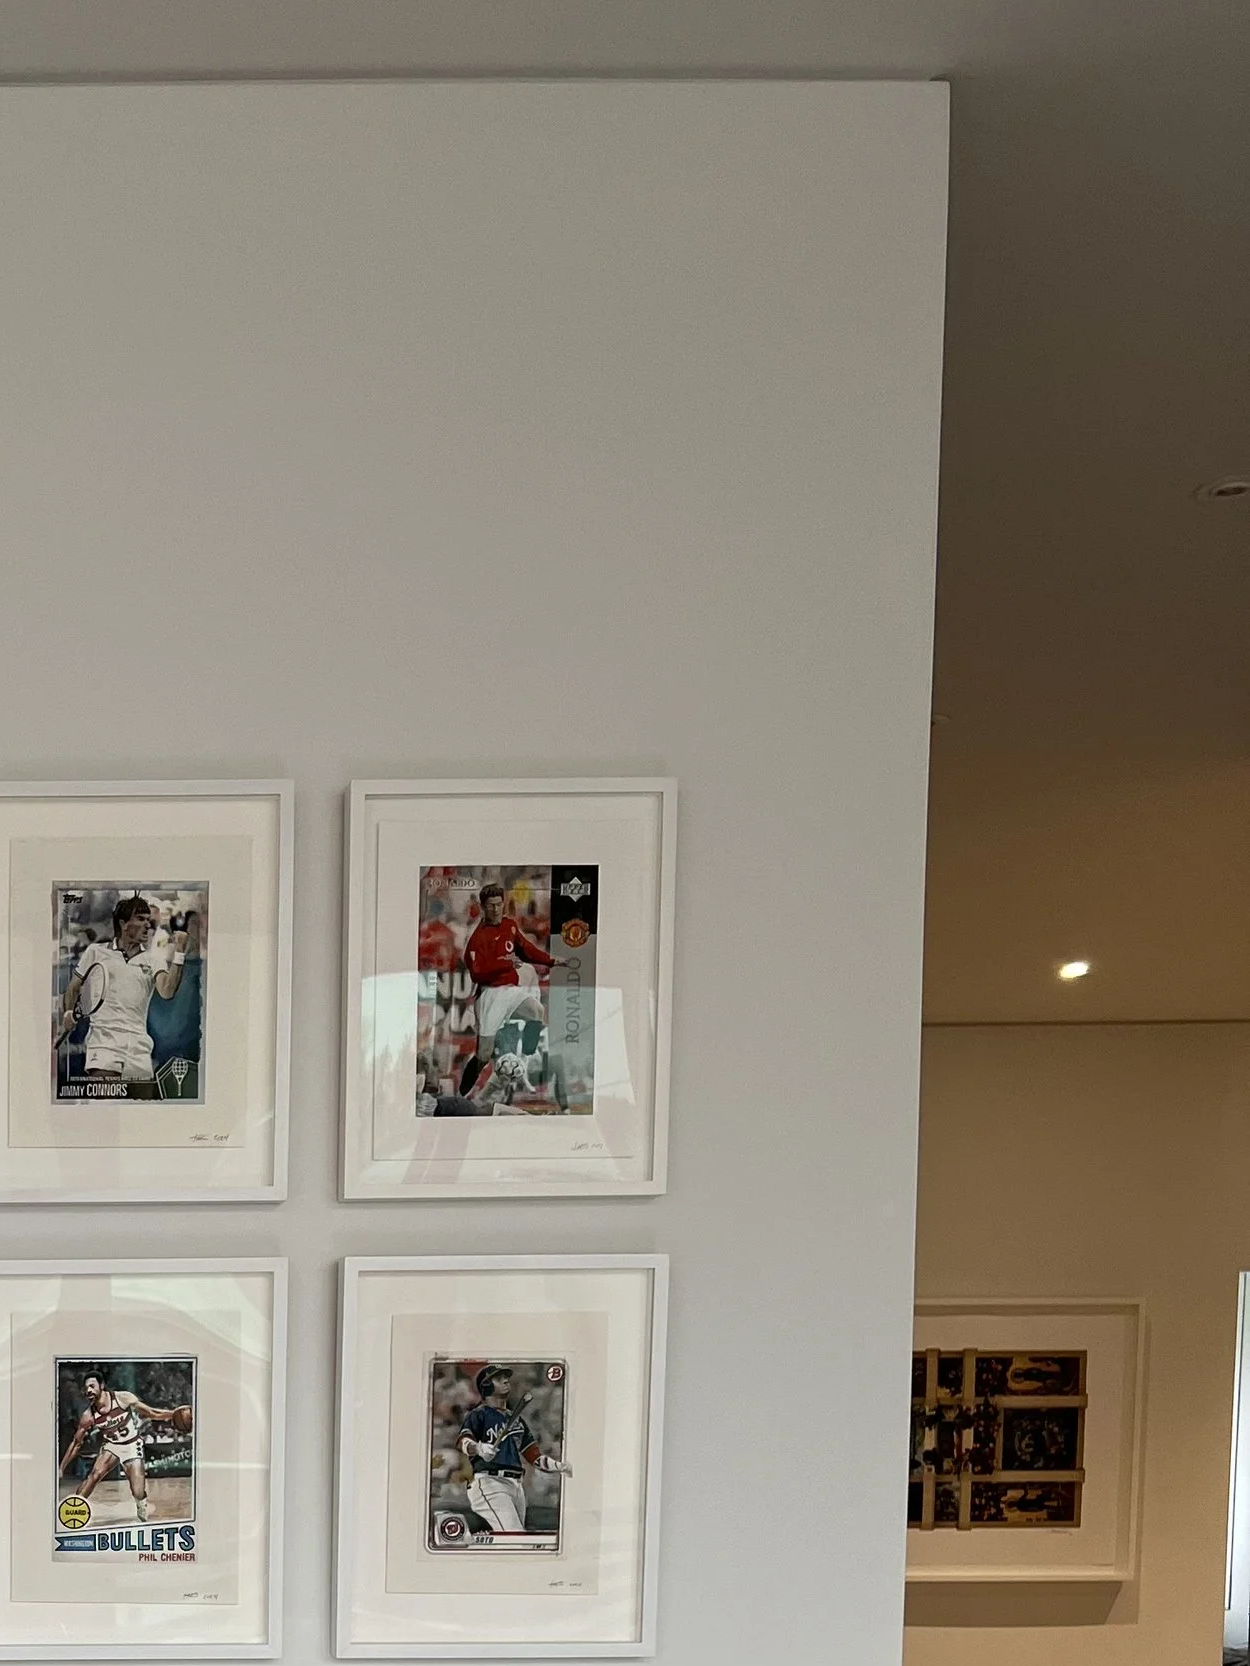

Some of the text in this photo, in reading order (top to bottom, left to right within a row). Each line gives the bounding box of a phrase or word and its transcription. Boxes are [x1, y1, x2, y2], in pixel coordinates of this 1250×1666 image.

[564, 956, 582, 1044] RONALDO
[59, 1083, 128, 1097] JIMMY CONNORS
[97, 1525, 196, 1552] BULLETS
[475, 1536, 494, 1544] SOTO
[138, 1553, 196, 1562] PHIL CHENIER
